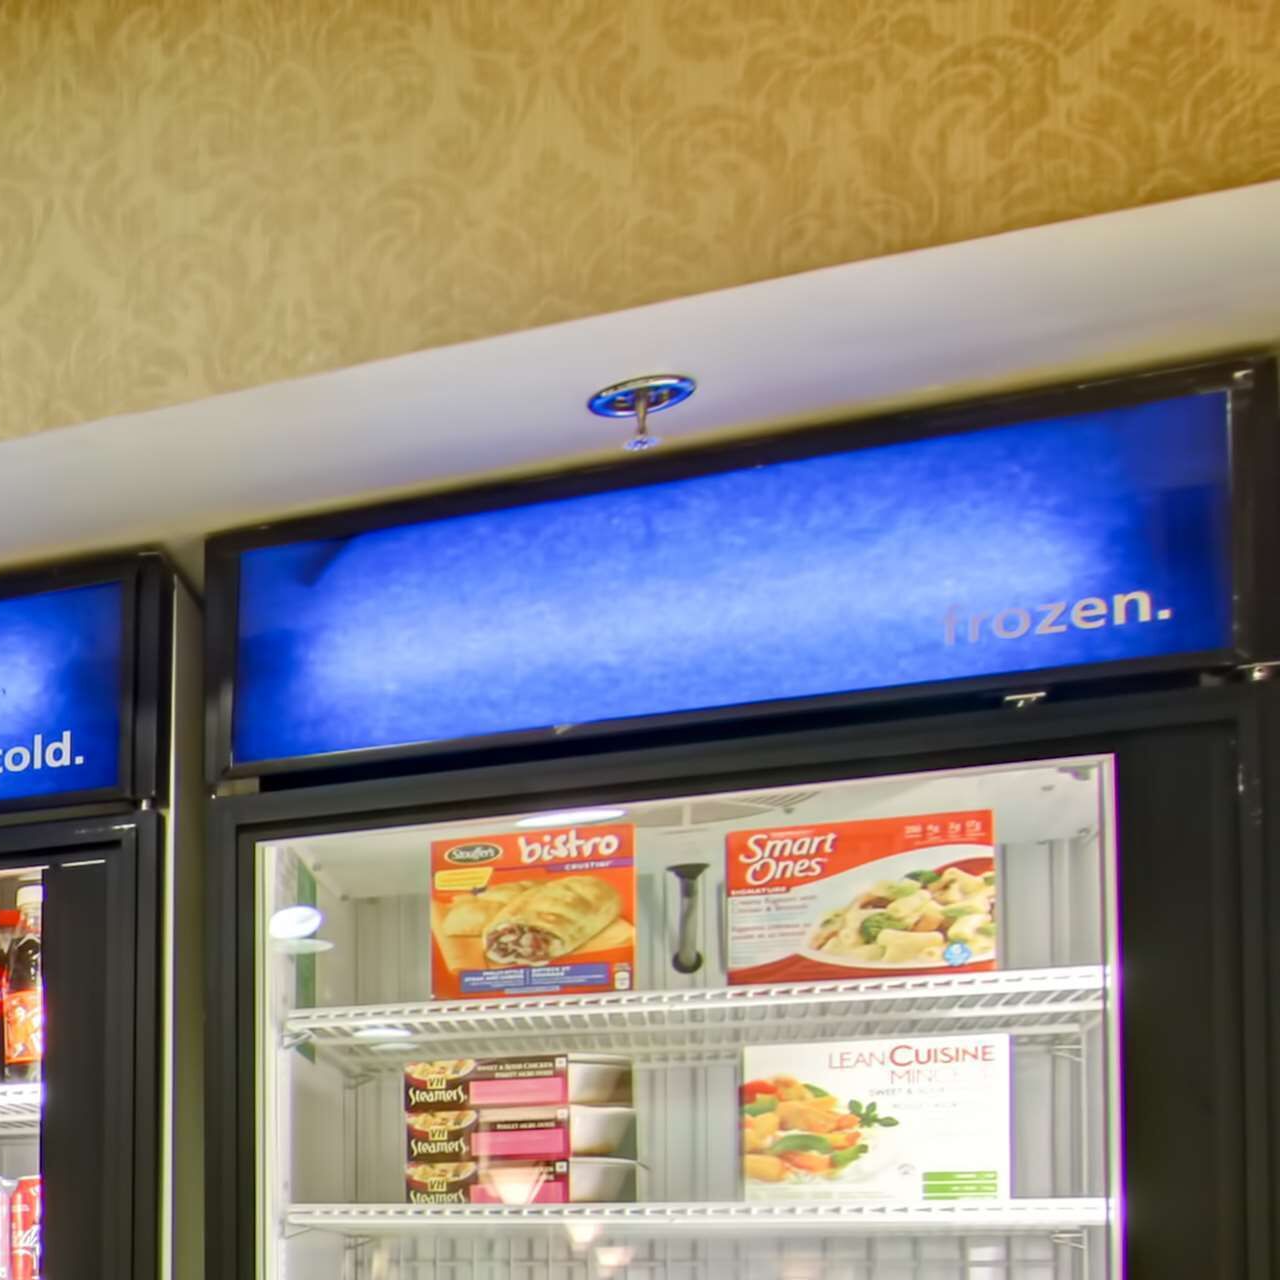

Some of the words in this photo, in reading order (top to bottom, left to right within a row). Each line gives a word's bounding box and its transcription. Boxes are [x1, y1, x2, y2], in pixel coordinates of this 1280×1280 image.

[943, 589, 1172, 647] frozen.
[517, 829, 619, 864] bistro
[738, 831, 838, 866] Smart
[744, 856, 826, 886] Ones
[828, 1050, 887, 1070] LEAN
